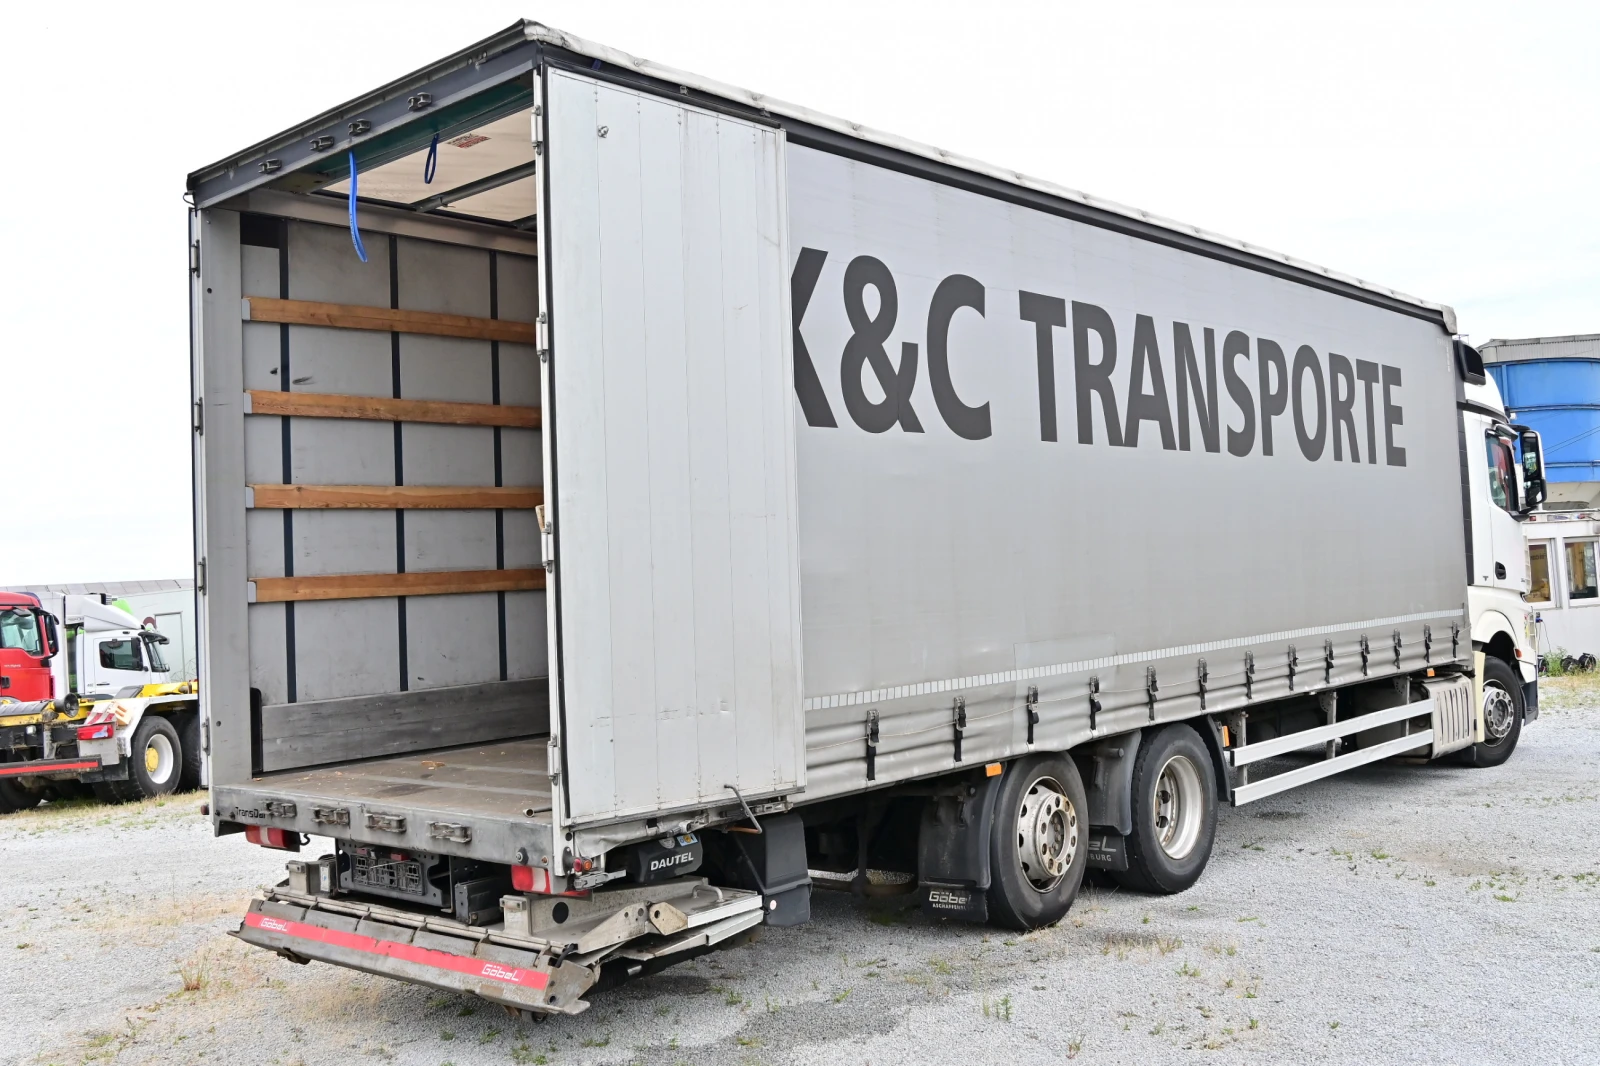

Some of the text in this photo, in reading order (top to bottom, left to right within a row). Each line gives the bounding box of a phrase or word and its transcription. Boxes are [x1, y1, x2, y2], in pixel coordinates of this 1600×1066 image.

[791, 246, 1407, 468] K&C TRANSPORTE
[650, 851, 694, 871] DAUTEL
